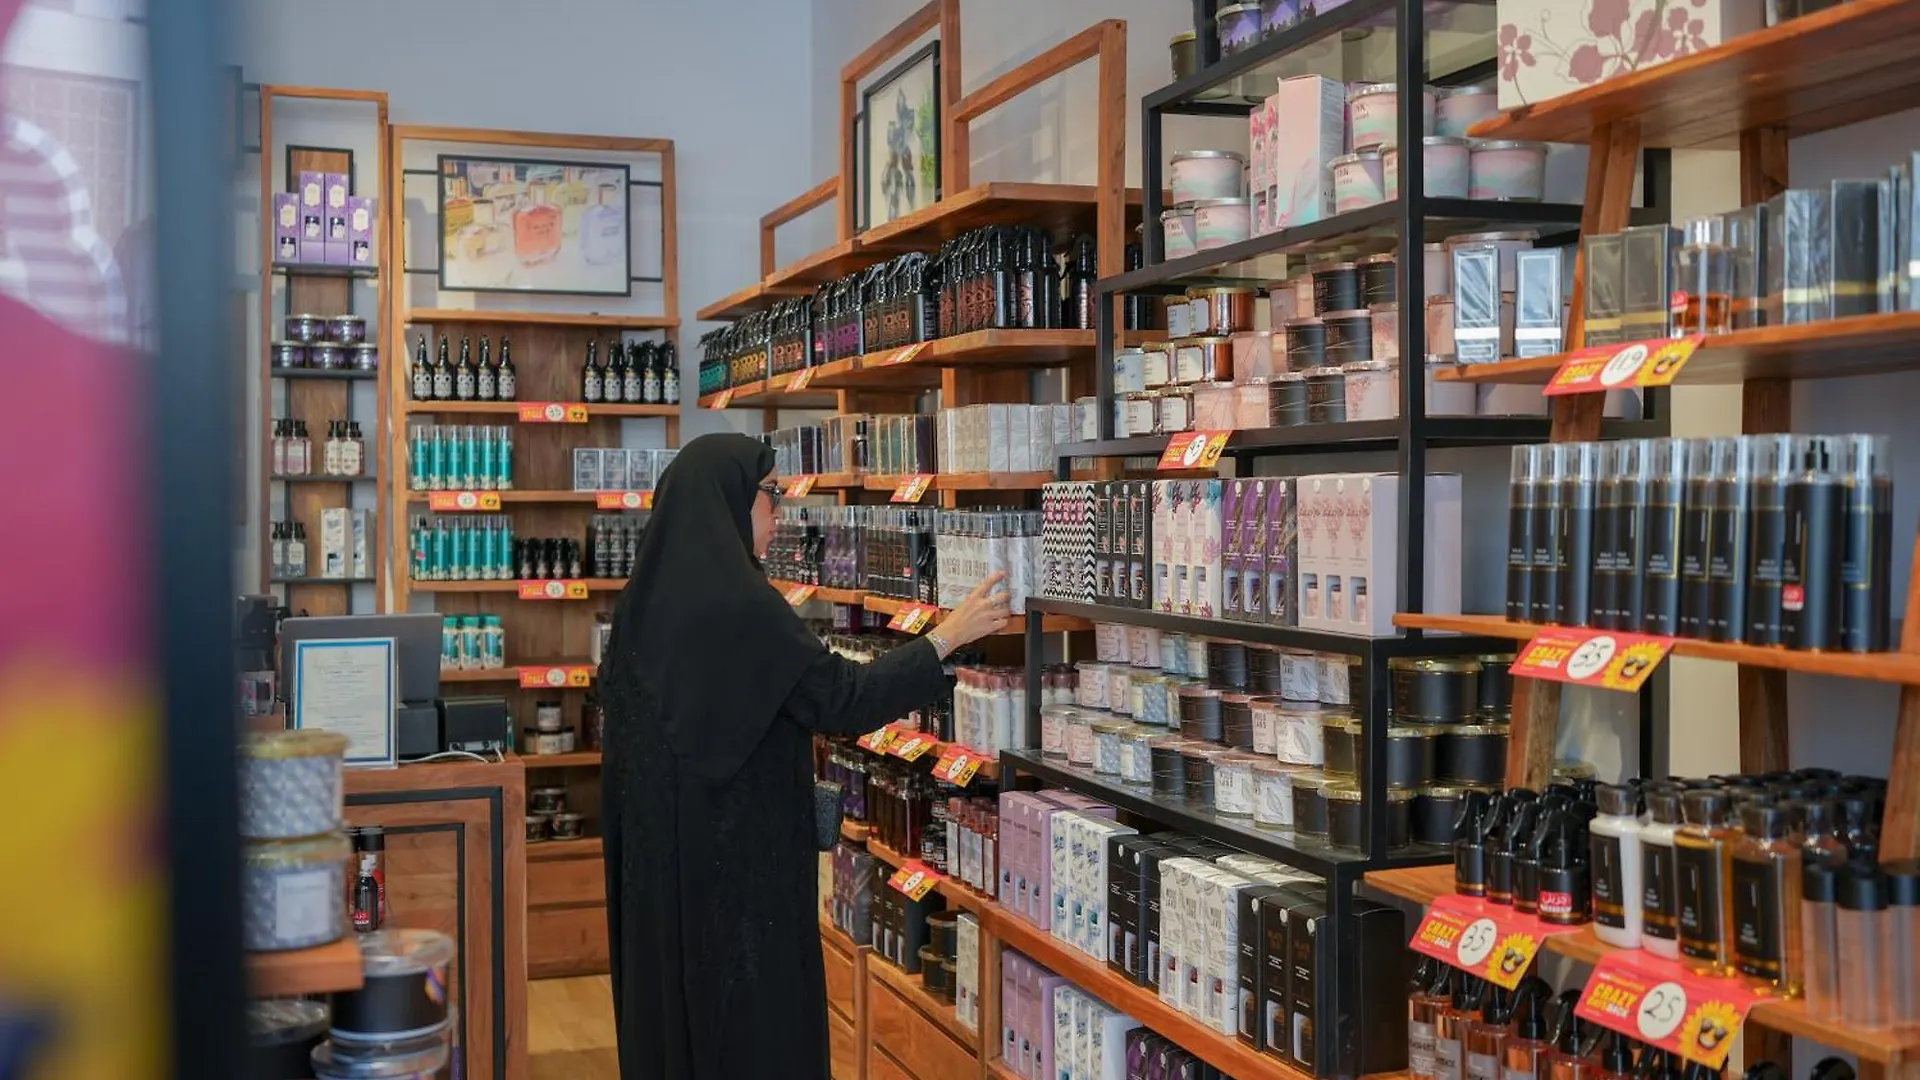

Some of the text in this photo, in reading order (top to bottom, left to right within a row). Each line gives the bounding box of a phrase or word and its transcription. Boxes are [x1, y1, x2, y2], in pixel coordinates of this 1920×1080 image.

[1461, 924, 1493, 952] 35
[1592, 981, 1639, 1008] CRAZY
[1643, 989, 1682, 1023] 25
